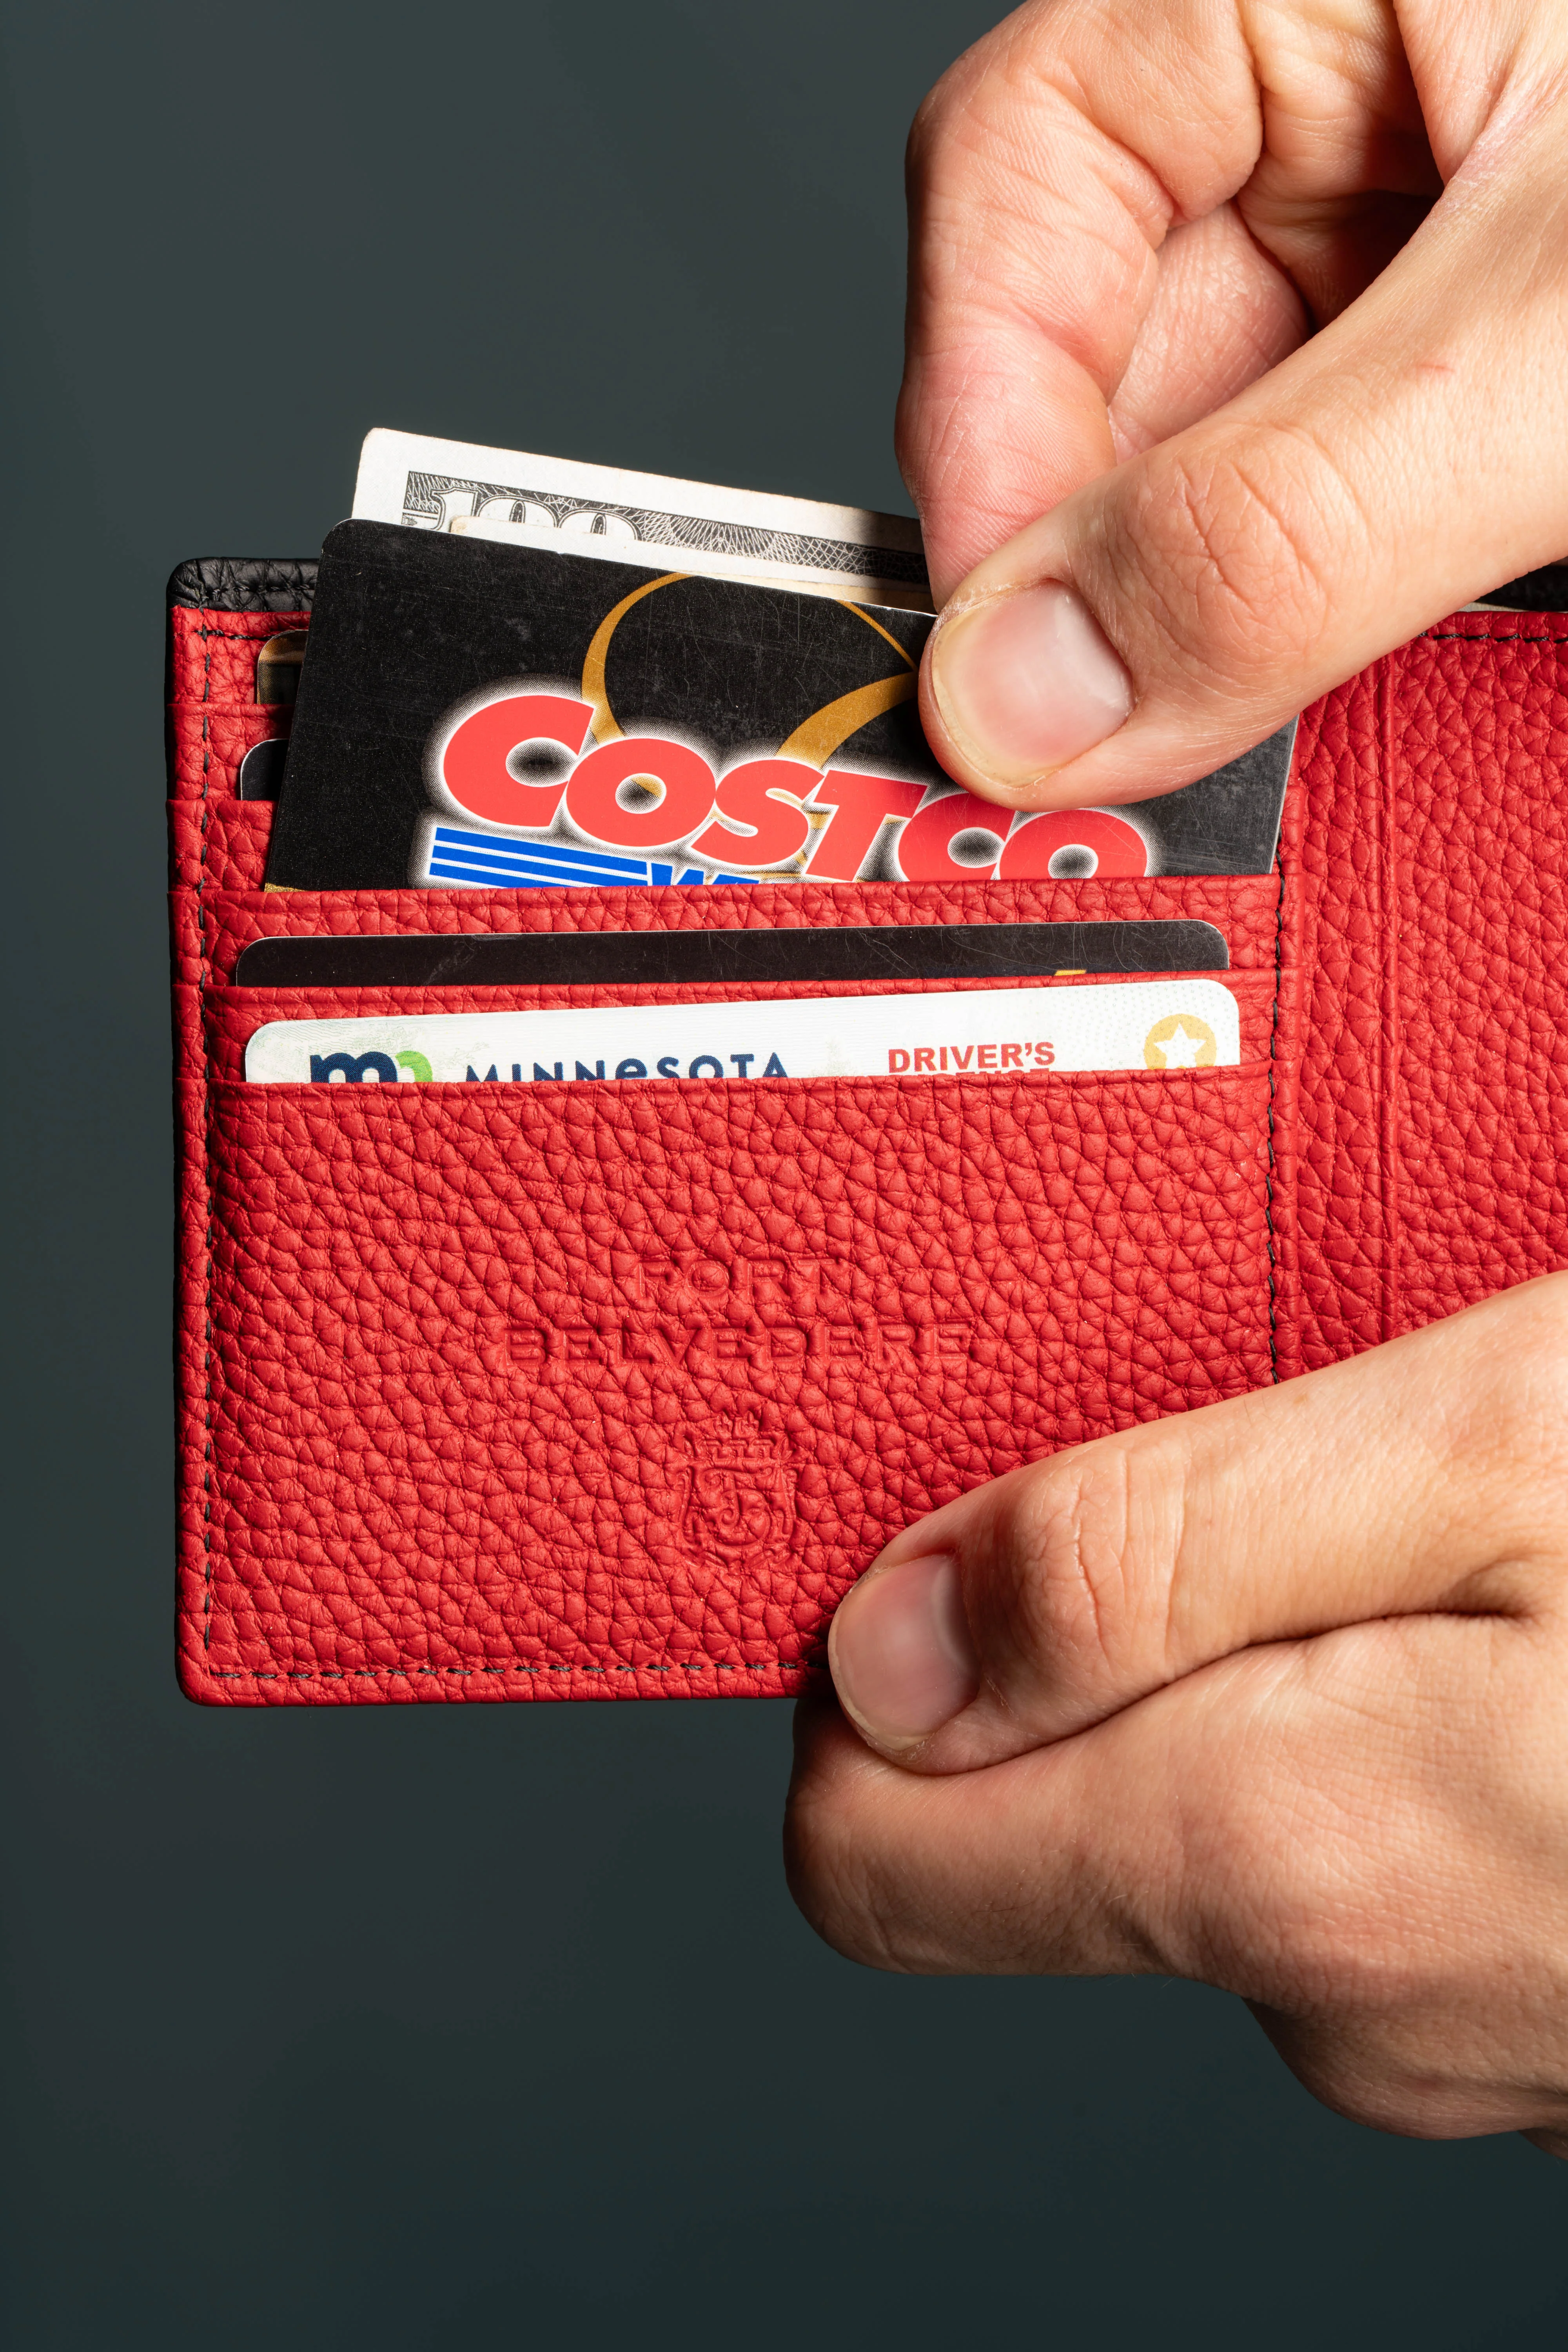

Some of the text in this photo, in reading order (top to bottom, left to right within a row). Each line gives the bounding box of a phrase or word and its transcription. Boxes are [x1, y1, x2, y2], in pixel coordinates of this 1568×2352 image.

[442, 694, 1148, 882] COSTCO
[888, 1042, 1055, 1073] DRIVER'S
[639, 1258, 835, 1298] FORT
[504, 1323, 970, 1366] BELVEDERE
